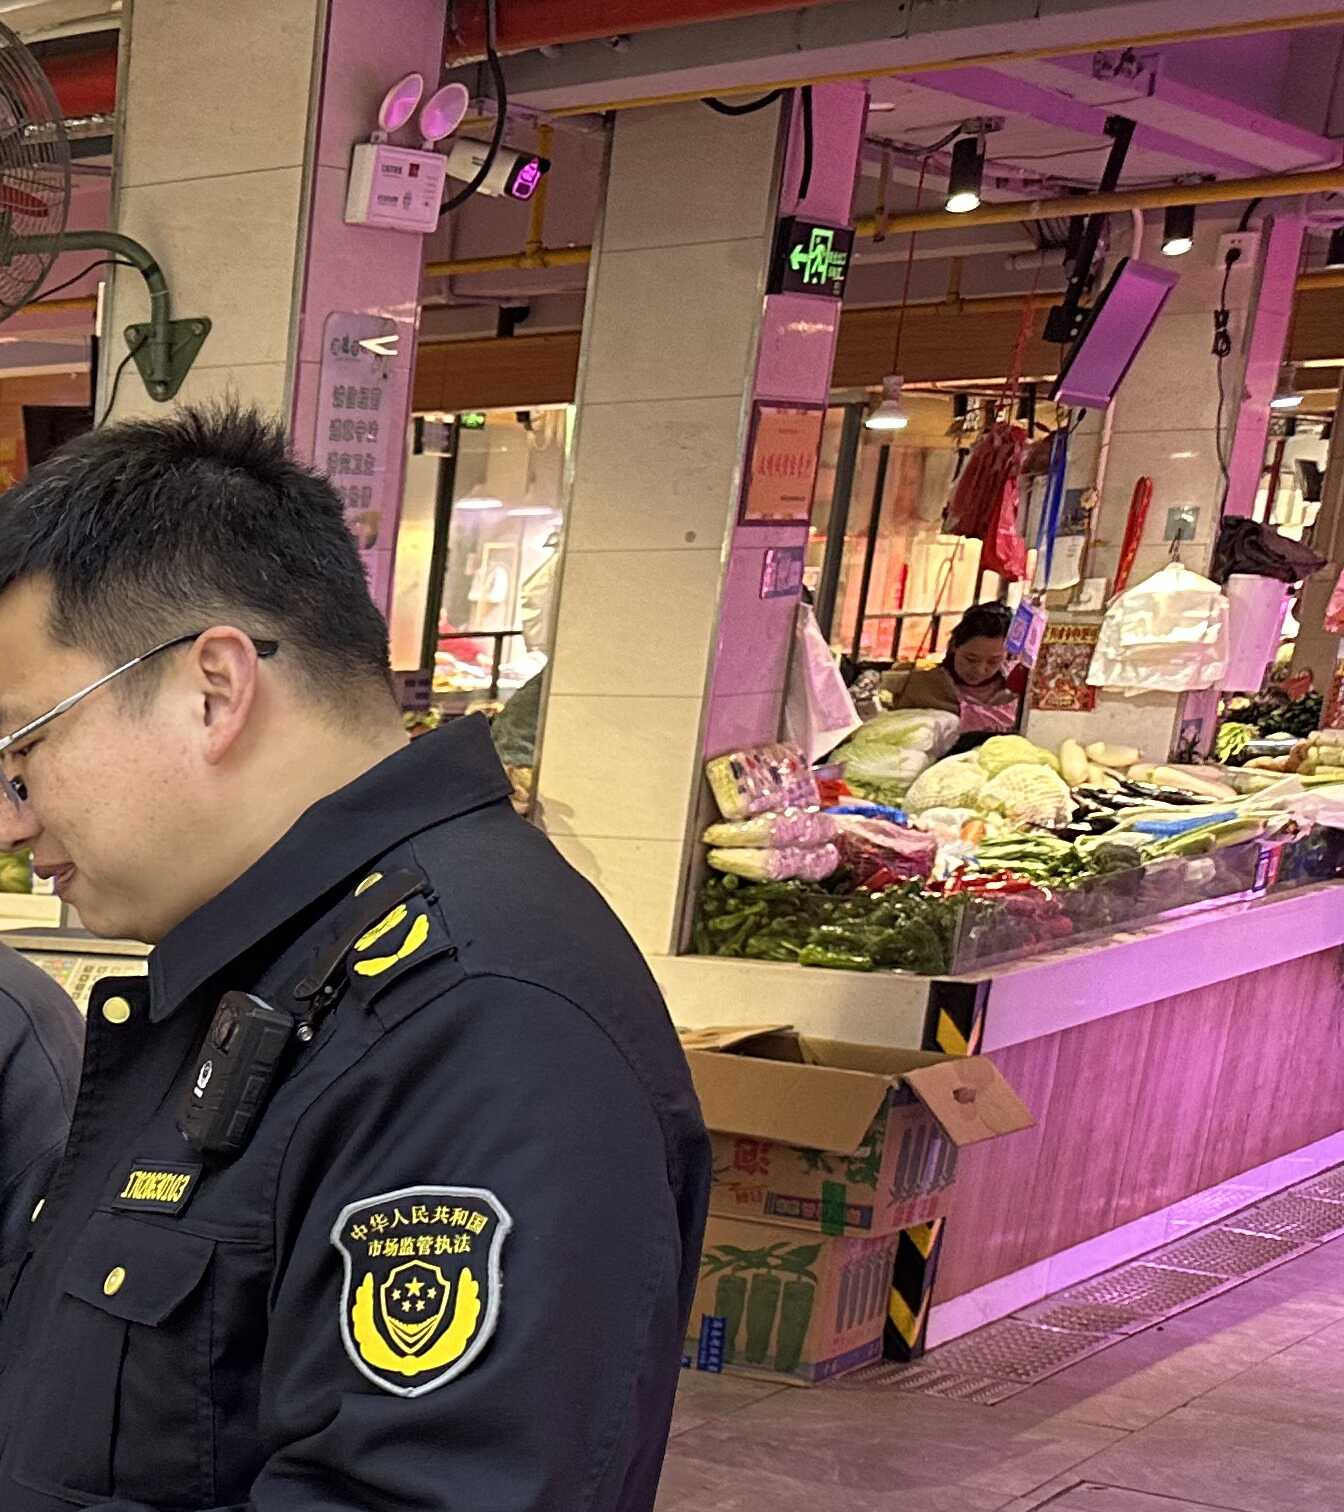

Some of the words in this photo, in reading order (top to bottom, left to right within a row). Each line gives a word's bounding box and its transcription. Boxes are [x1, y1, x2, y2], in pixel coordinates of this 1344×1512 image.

[350, 1204, 489, 1241] 中华人民共和国
[367, 1233, 472, 1258] 市场监管执法
